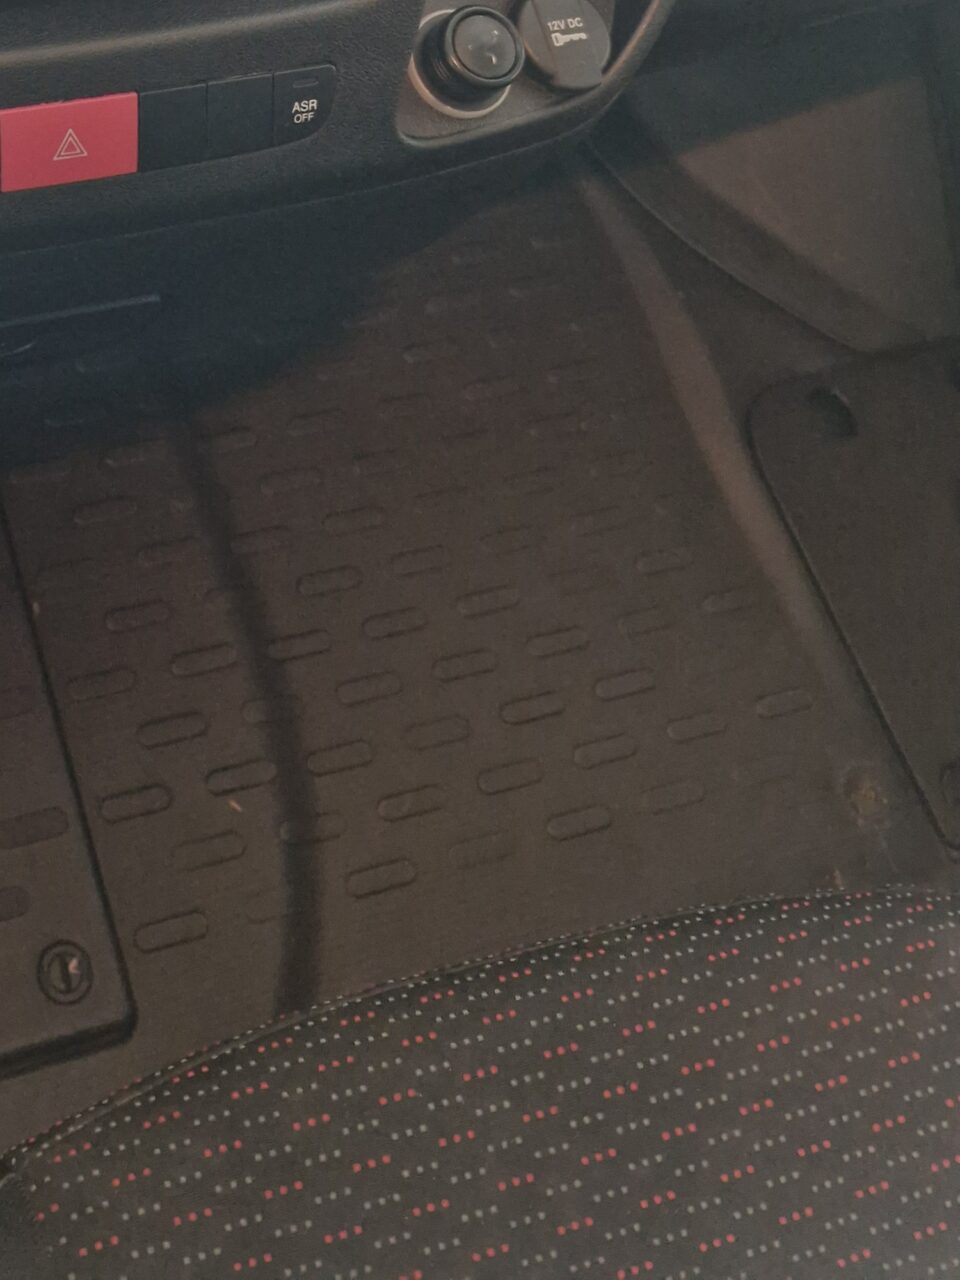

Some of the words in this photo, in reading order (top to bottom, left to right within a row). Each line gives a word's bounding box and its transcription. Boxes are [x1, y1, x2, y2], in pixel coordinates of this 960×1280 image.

[547, 20, 565, 31] 12V
[567, 17, 584, 29] DC
[292, 99, 317, 113] ASR
[294, 112, 315, 124] OFF
